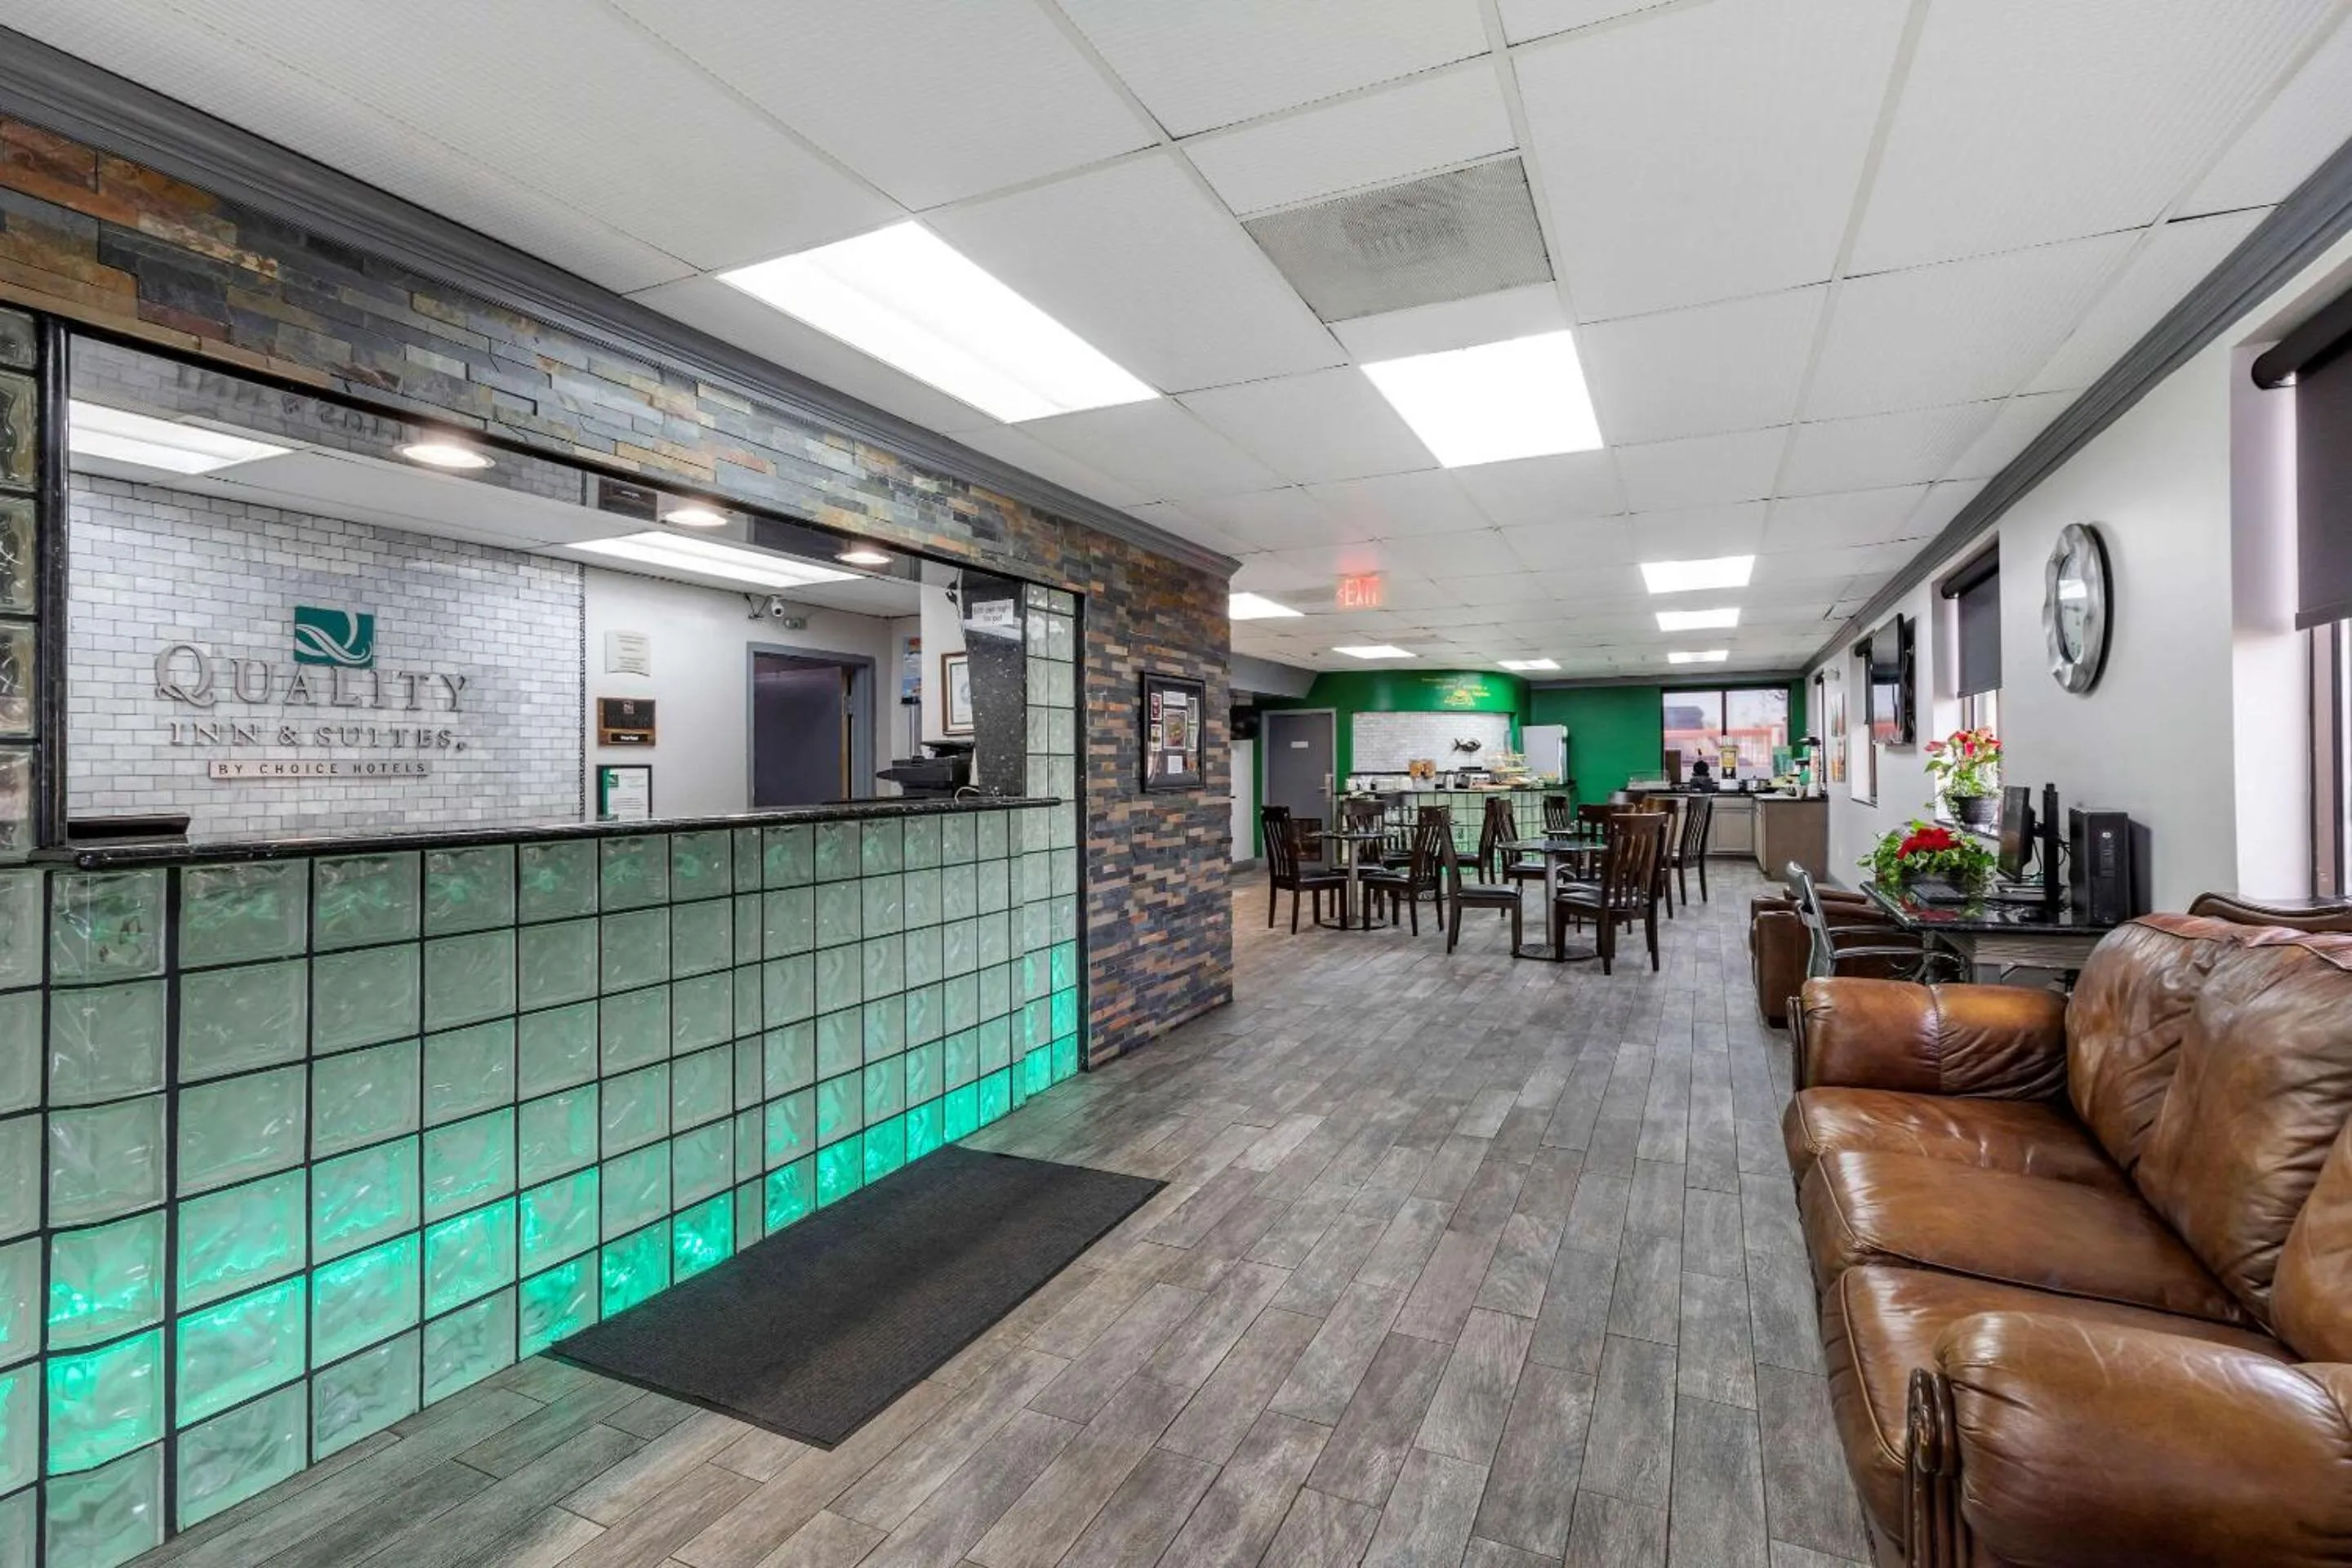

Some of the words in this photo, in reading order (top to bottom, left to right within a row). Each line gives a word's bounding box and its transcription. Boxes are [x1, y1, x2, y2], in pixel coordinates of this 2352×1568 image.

[1344, 577, 1380, 607] EXIT
[154, 644, 466, 712] QUALITY
[169, 721, 260, 746] INN
[277, 725, 300, 746] &
[218, 764, 243, 773] BY
[259, 763, 337, 774] CHOICE
[354, 763, 425, 773] HOTELS
